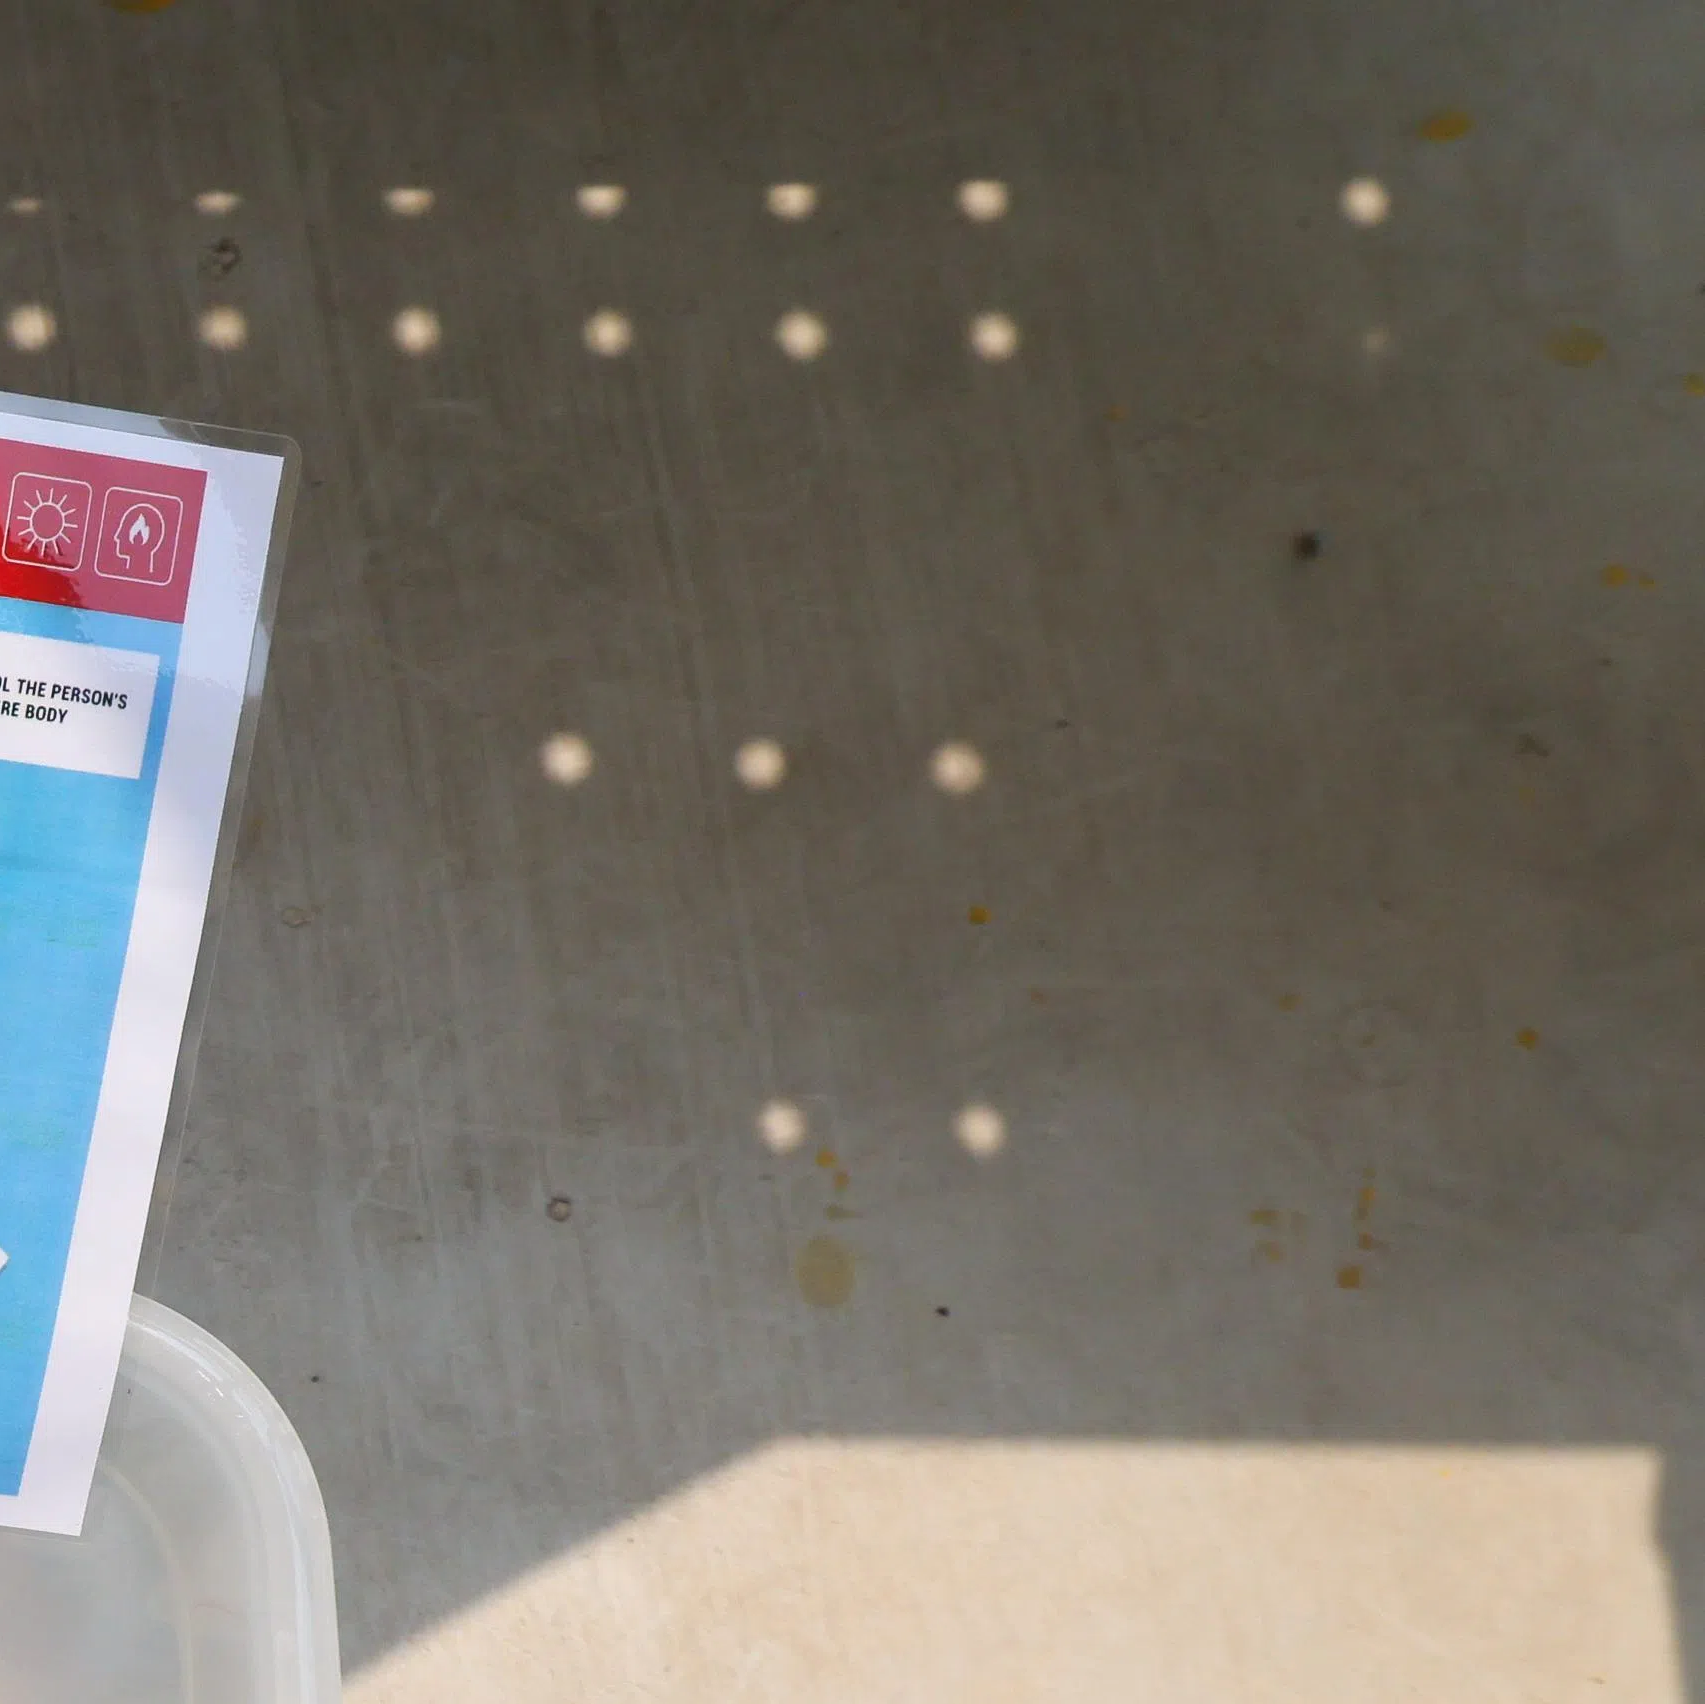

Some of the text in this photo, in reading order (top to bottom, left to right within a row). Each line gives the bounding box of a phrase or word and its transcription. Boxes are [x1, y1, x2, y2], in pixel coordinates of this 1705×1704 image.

[17, 679, 46, 697] THE
[51, 684, 128, 709] PERSON'S
[25, 705, 68, 724] BODY
